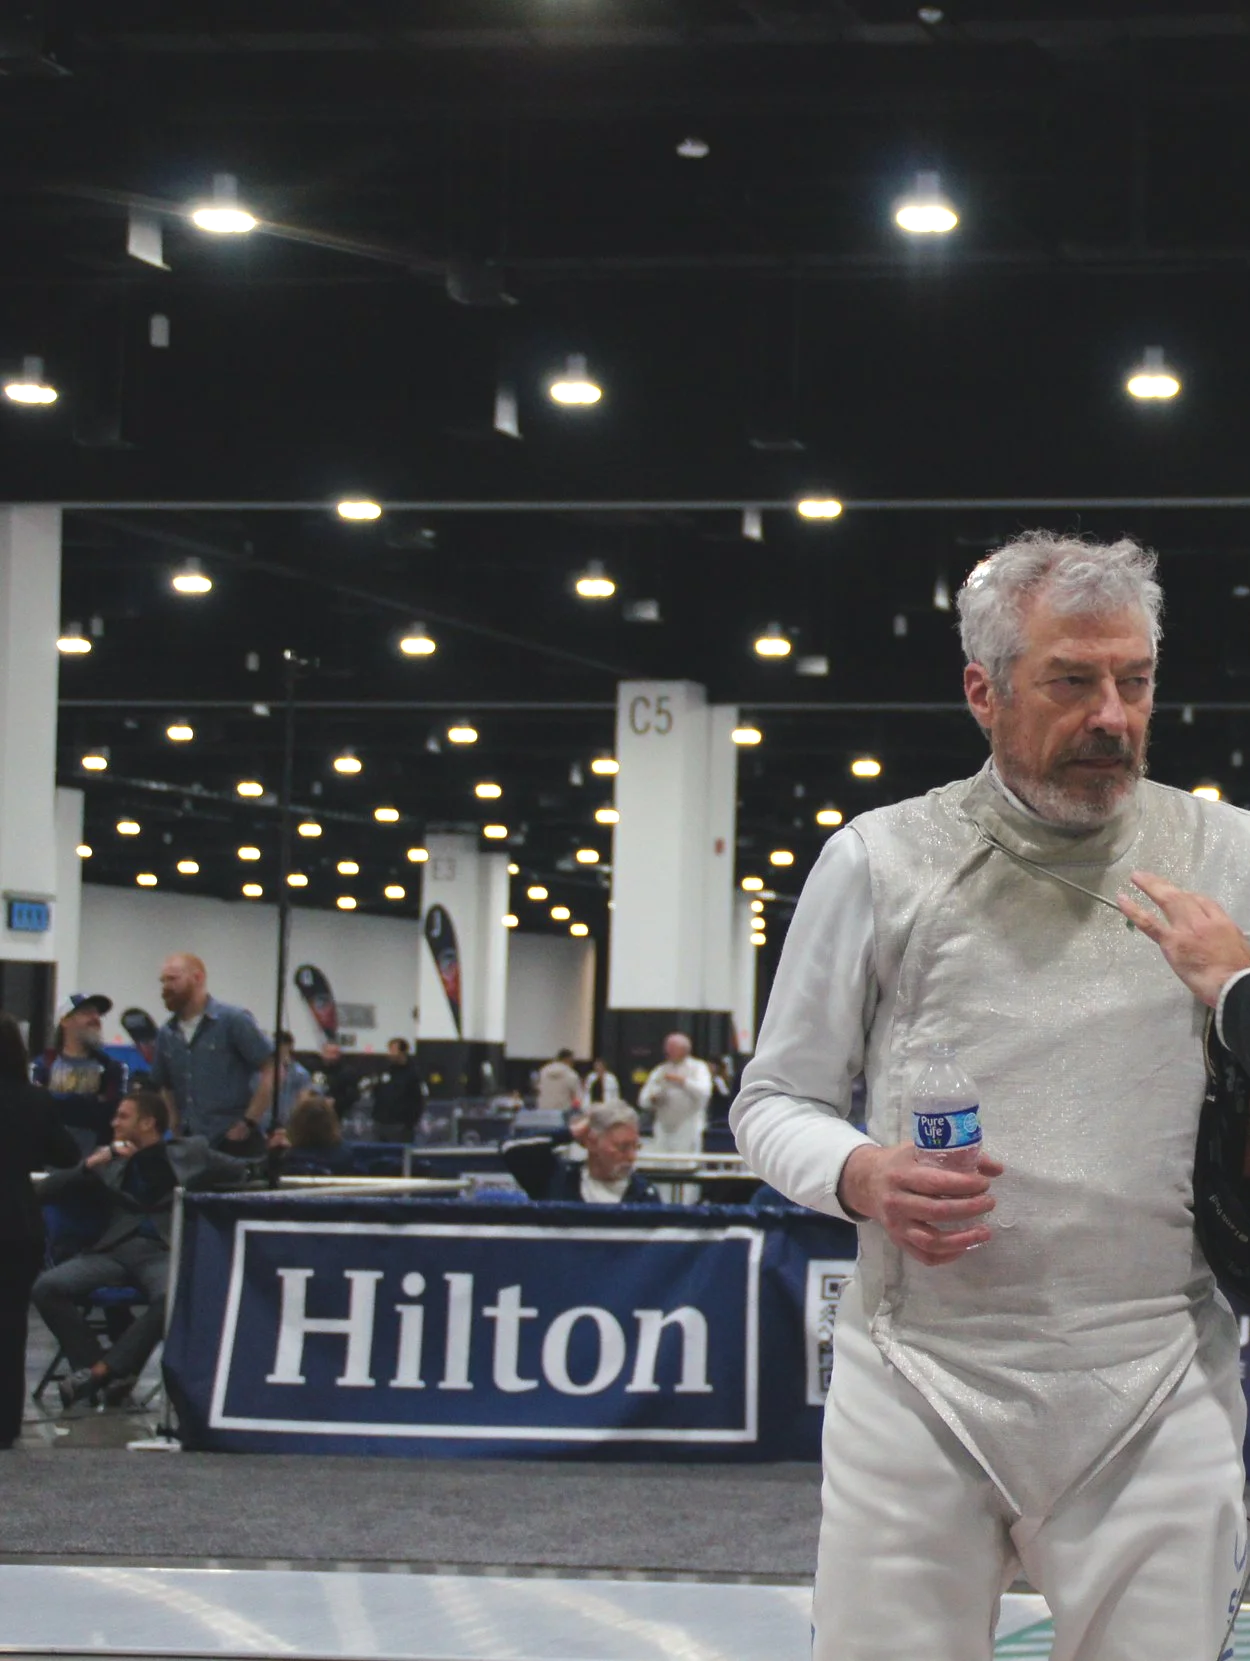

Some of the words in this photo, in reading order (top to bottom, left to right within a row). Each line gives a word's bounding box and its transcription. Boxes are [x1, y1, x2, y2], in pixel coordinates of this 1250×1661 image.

[629, 695, 673, 736] C5
[920, 1116, 945, 1126] Pure
[924, 1126, 943, 1138] Life
[266, 1268, 713, 1395] Hilton
